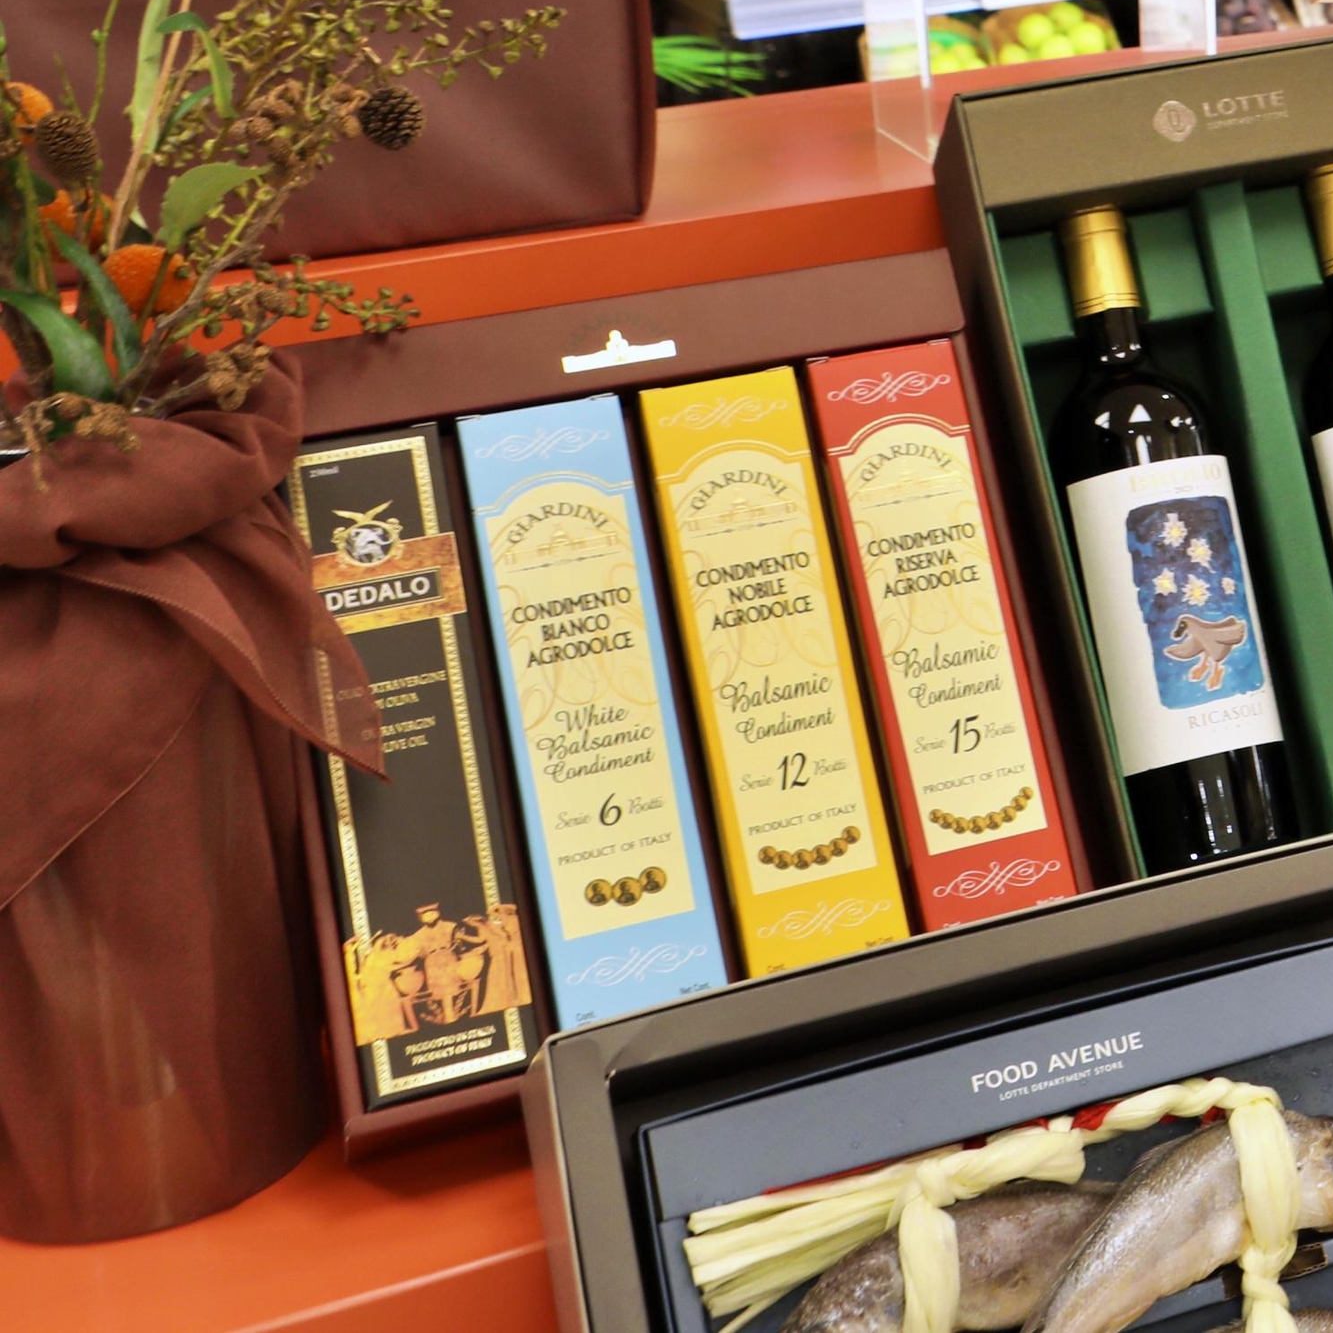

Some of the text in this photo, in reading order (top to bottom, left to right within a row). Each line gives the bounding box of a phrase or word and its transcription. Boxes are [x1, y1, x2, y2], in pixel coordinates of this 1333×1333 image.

[1202, 90, 1285, 117] LOTTE
[860, 442, 953, 483] GIARDINI
[691, 469, 788, 511] GIARDINI
[507, 502, 609, 545] GIARDINI
[867, 522, 976, 558] CONDIMENTO
[696, 551, 810, 588] CONDIMENTO
[895, 548, 958, 575] RISERVA
[324, 575, 431, 613] DEDALO
[727, 577, 788, 605] NOBILE
[884, 564, 981, 600] AGRODOLCE
[511, 586, 632, 624] CONDIMENTO
[712, 595, 815, 632] AGRODOLCE
[541, 613, 611, 642] BIANCO
[527, 631, 635, 669] AGRODOLCE
[891, 640, 1000, 679] Balsamic
[719, 673, 833, 714] Balsamic
[908, 673, 1004, 709] Condiment
[554, 703, 629, 734] White
[735, 707, 837, 744] Condiment
[949, 714, 981, 755] 15
[535, 723, 656, 762] Balsamic
[543, 747, 656, 784] Condiment
[776, 752, 811, 791] 12
[922, 763, 1026, 795] PRODUCT OF ITALY
[599, 792, 622, 827] 6
[748, 802, 858, 837] PRODUCT OF ITALY
[557, 831, 672, 867] PRODUCT OF ITALY
[970, 1031, 1144, 1094] FOOD AVENUE
[998, 1060, 1125, 1102] LOTTE DEPARTMENT STORE
